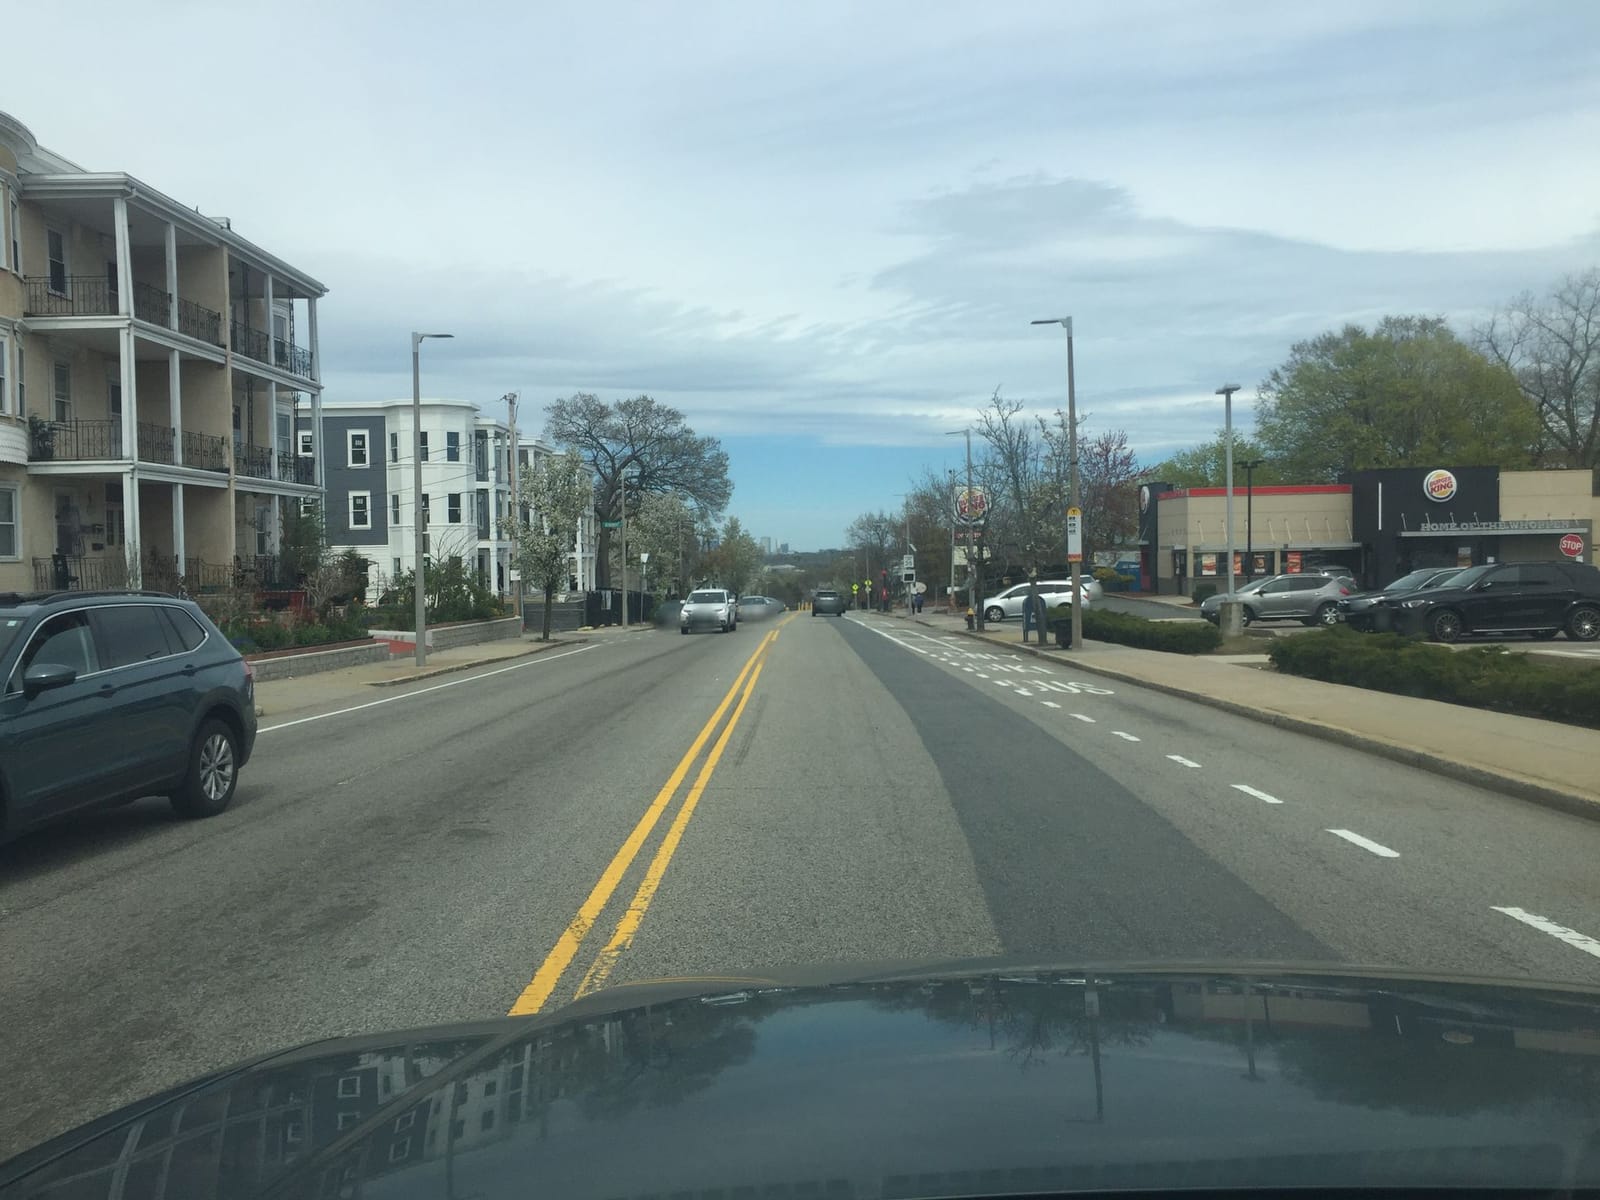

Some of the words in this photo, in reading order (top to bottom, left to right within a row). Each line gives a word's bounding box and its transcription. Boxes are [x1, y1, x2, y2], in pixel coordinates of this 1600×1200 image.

[1429, 475, 1452, 486] BURGER
[1430, 481, 1454, 494] KING
[1420, 521, 1456, 532] HOME
[1478, 520, 1507, 530] THE
[1508, 520, 1570, 529] WHOPPER
[1561, 540, 1583, 550] STOP
